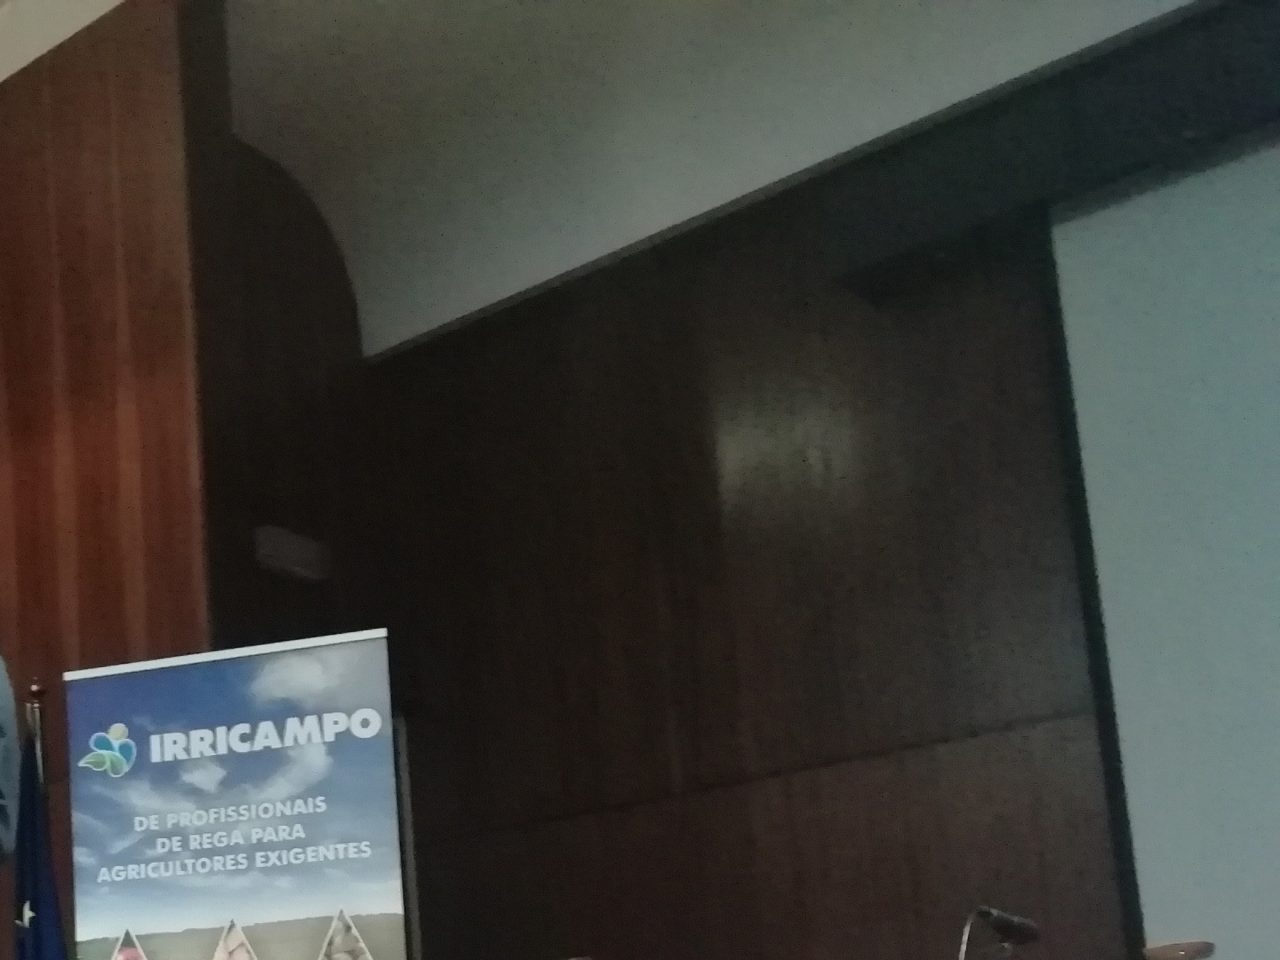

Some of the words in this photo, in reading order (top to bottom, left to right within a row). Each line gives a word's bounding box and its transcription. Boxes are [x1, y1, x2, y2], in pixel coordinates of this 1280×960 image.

[150, 708, 382, 763] IRRICAMPO
[134, 815, 159, 832] DE
[167, 796, 328, 829] PROFISSIONAIS
[156, 836, 182, 853] DE
[189, 829, 245, 850] REGA
[251, 823, 306, 844] PARA
[97, 854, 248, 883] AGRICULTORES
[255, 841, 372, 869] EXIGENTES
